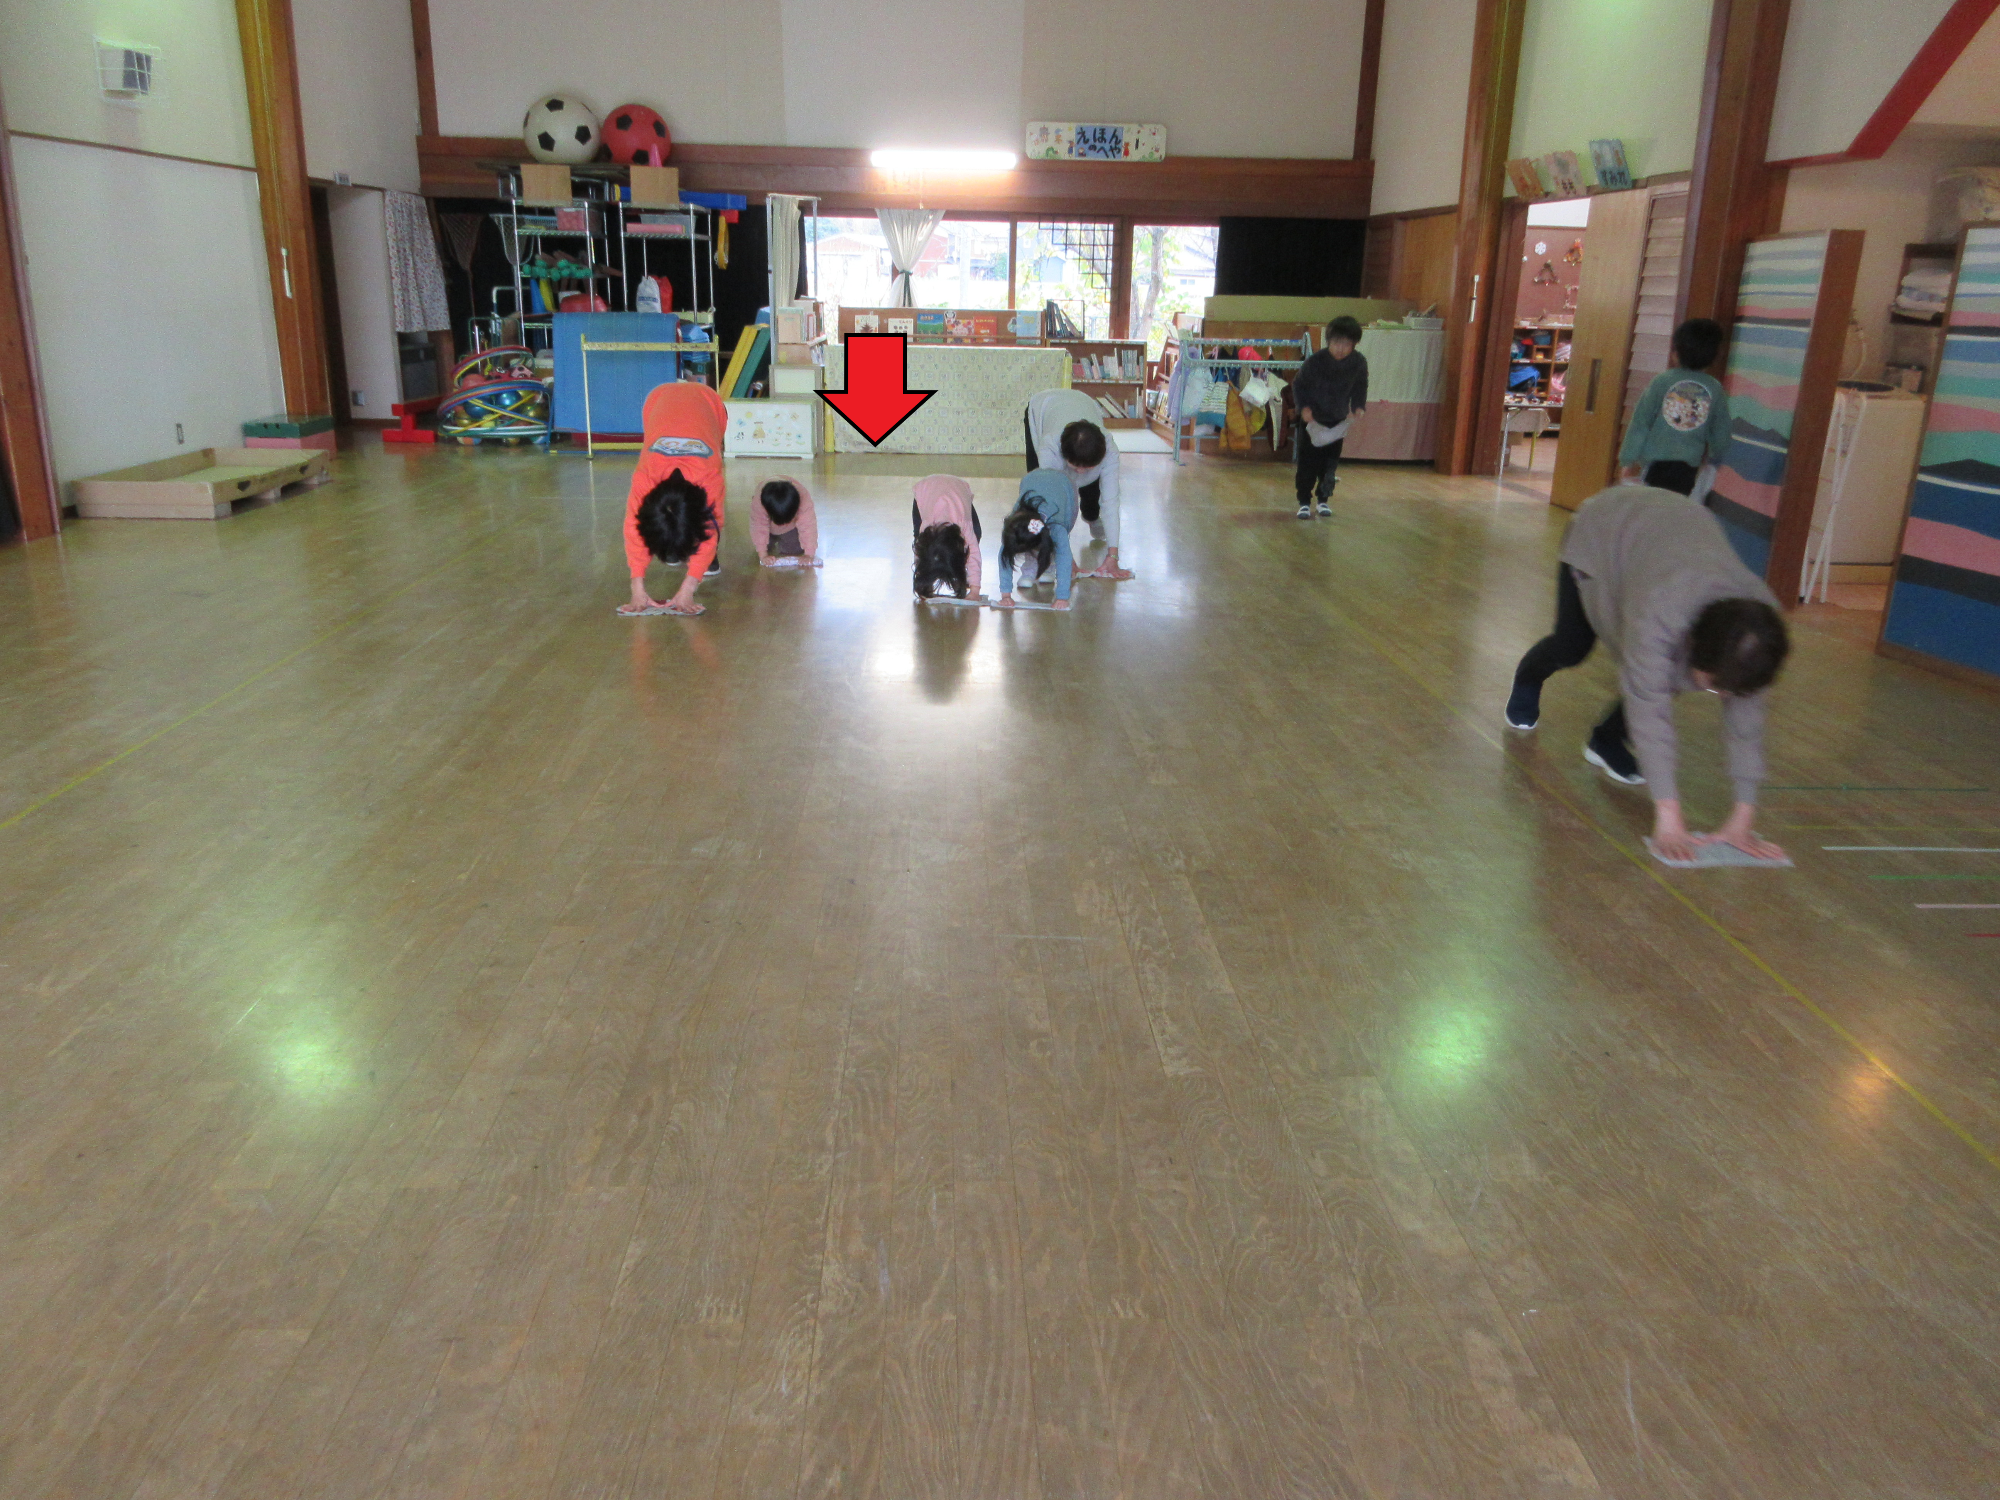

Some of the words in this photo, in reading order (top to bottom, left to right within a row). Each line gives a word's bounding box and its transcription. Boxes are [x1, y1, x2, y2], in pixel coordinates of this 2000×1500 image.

[1076, 127, 1122, 145] えほん
[1088, 144, 1121, 158] のへや
